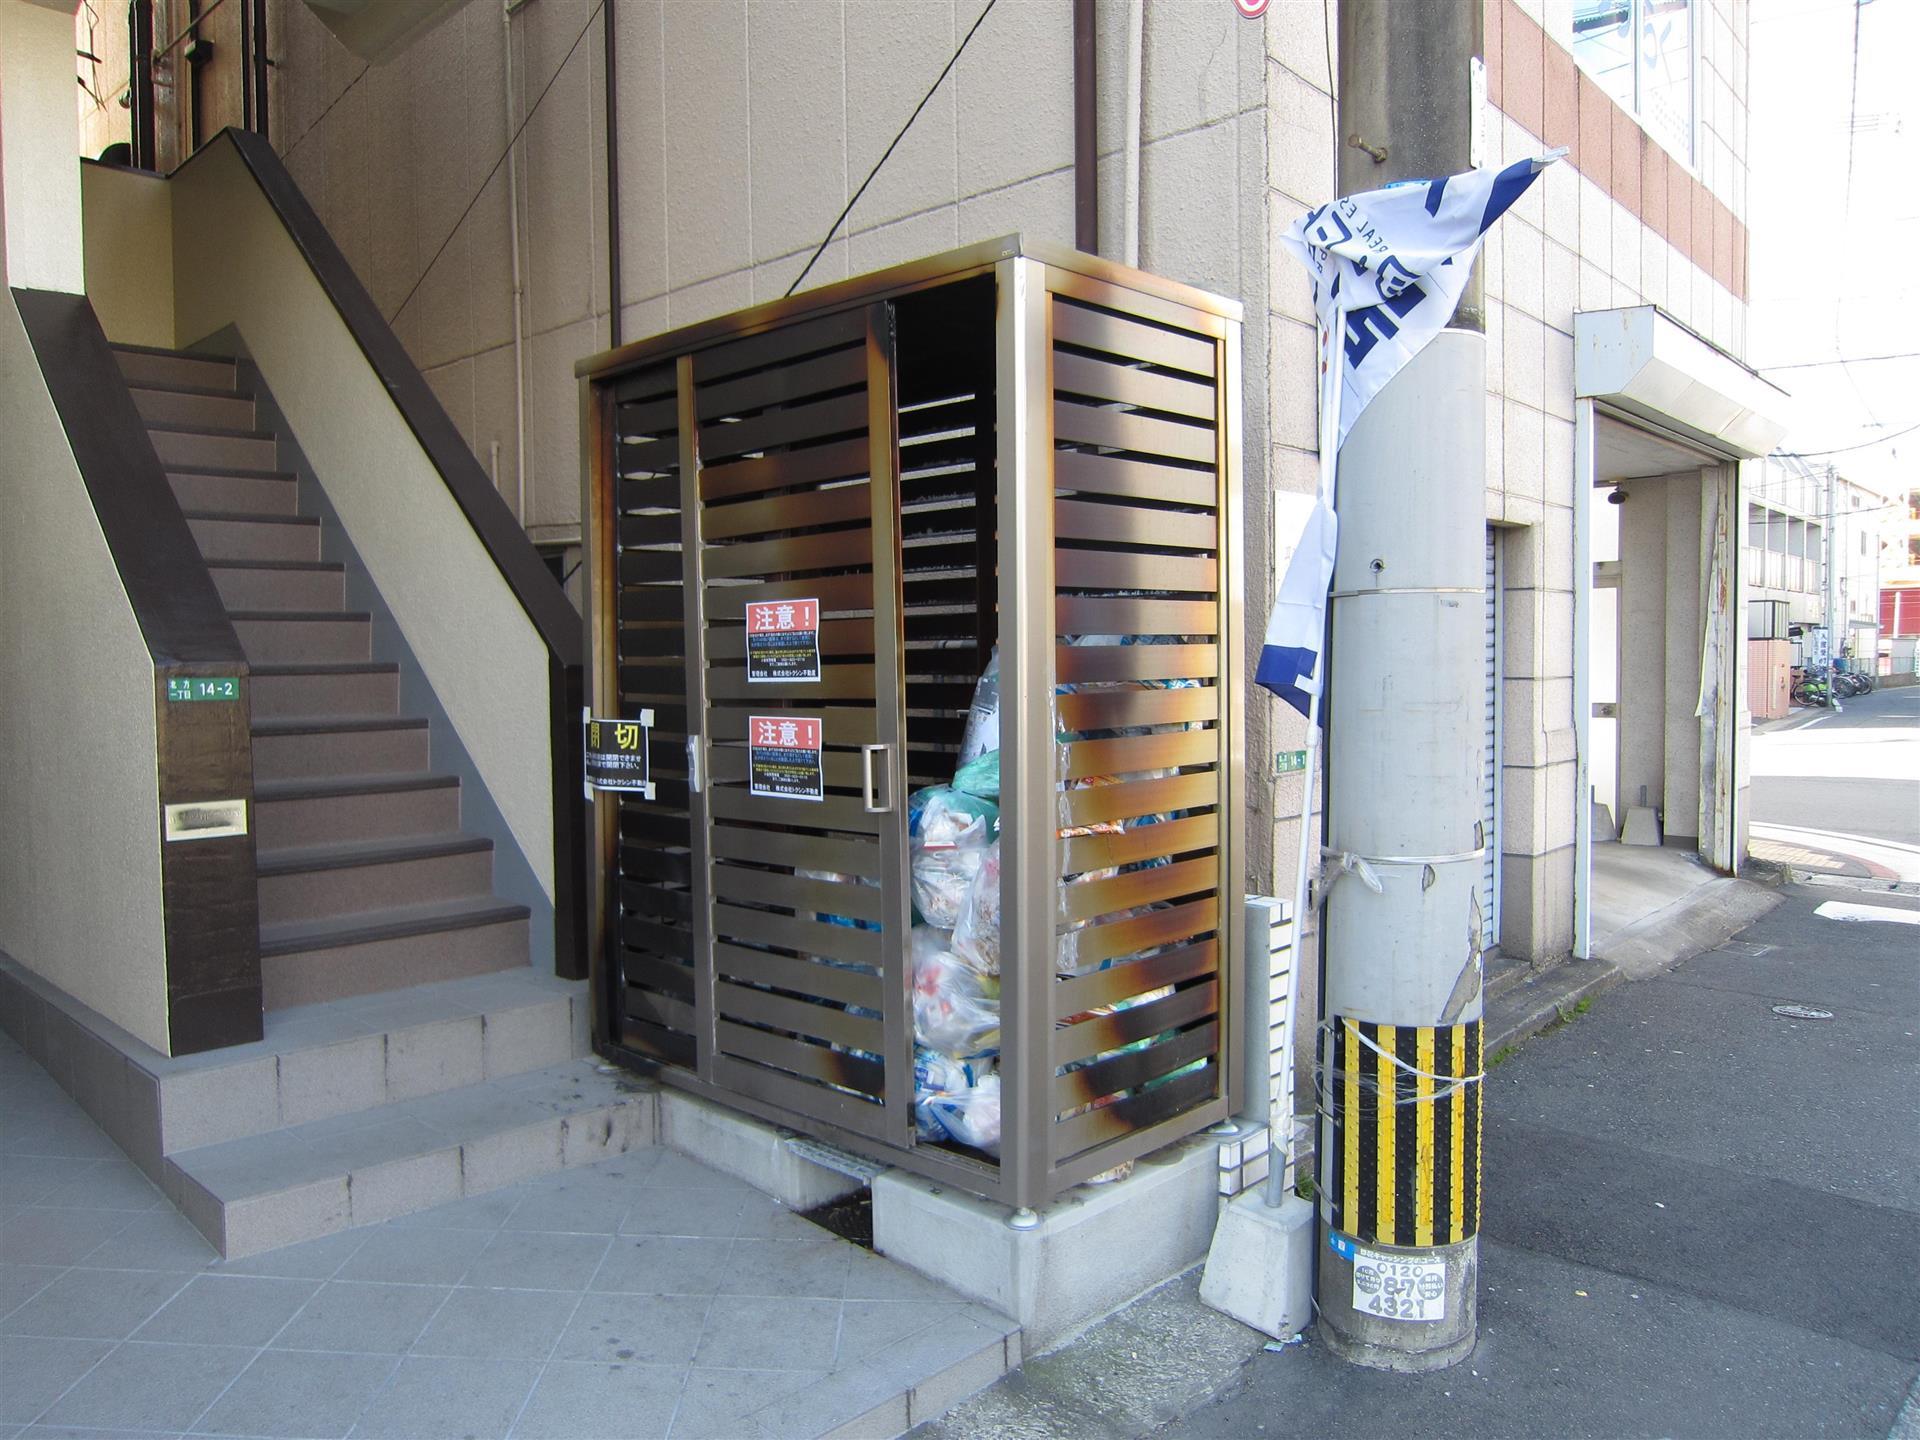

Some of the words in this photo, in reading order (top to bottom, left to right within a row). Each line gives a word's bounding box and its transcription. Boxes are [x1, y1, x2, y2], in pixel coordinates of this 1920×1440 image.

[200, 682, 233, 696] 14-2
[1377, 1263, 1423, 1278] 0120
[1368, 1294, 1424, 1319] 4321
